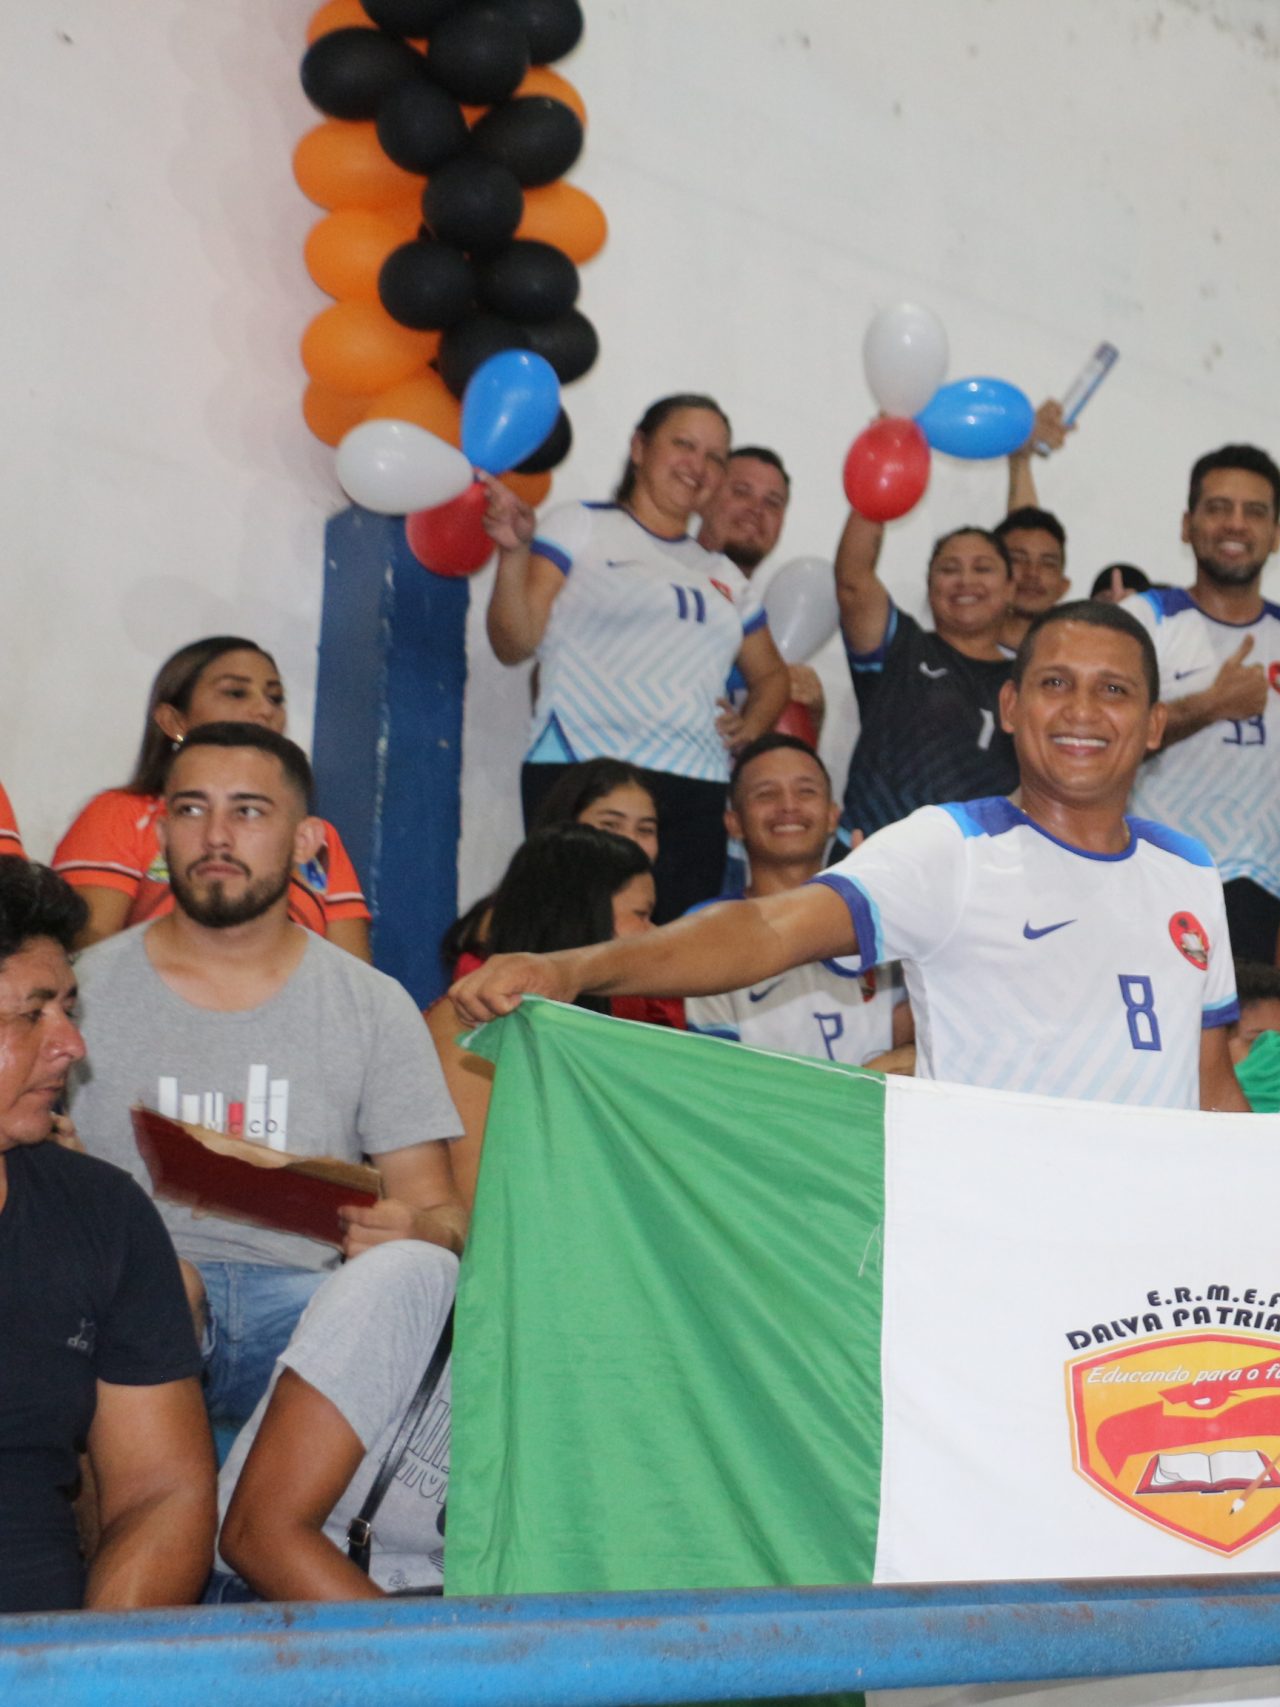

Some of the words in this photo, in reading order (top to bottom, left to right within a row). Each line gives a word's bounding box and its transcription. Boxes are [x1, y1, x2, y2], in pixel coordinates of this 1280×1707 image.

[1118, 974, 1162, 1052] 8
[1065, 1312, 1164, 1350] DALVA
[1087, 1366, 1190, 1384] Educando
[1193, 1369, 1241, 1386] para
[1247, 1368, 1259, 1380] o
